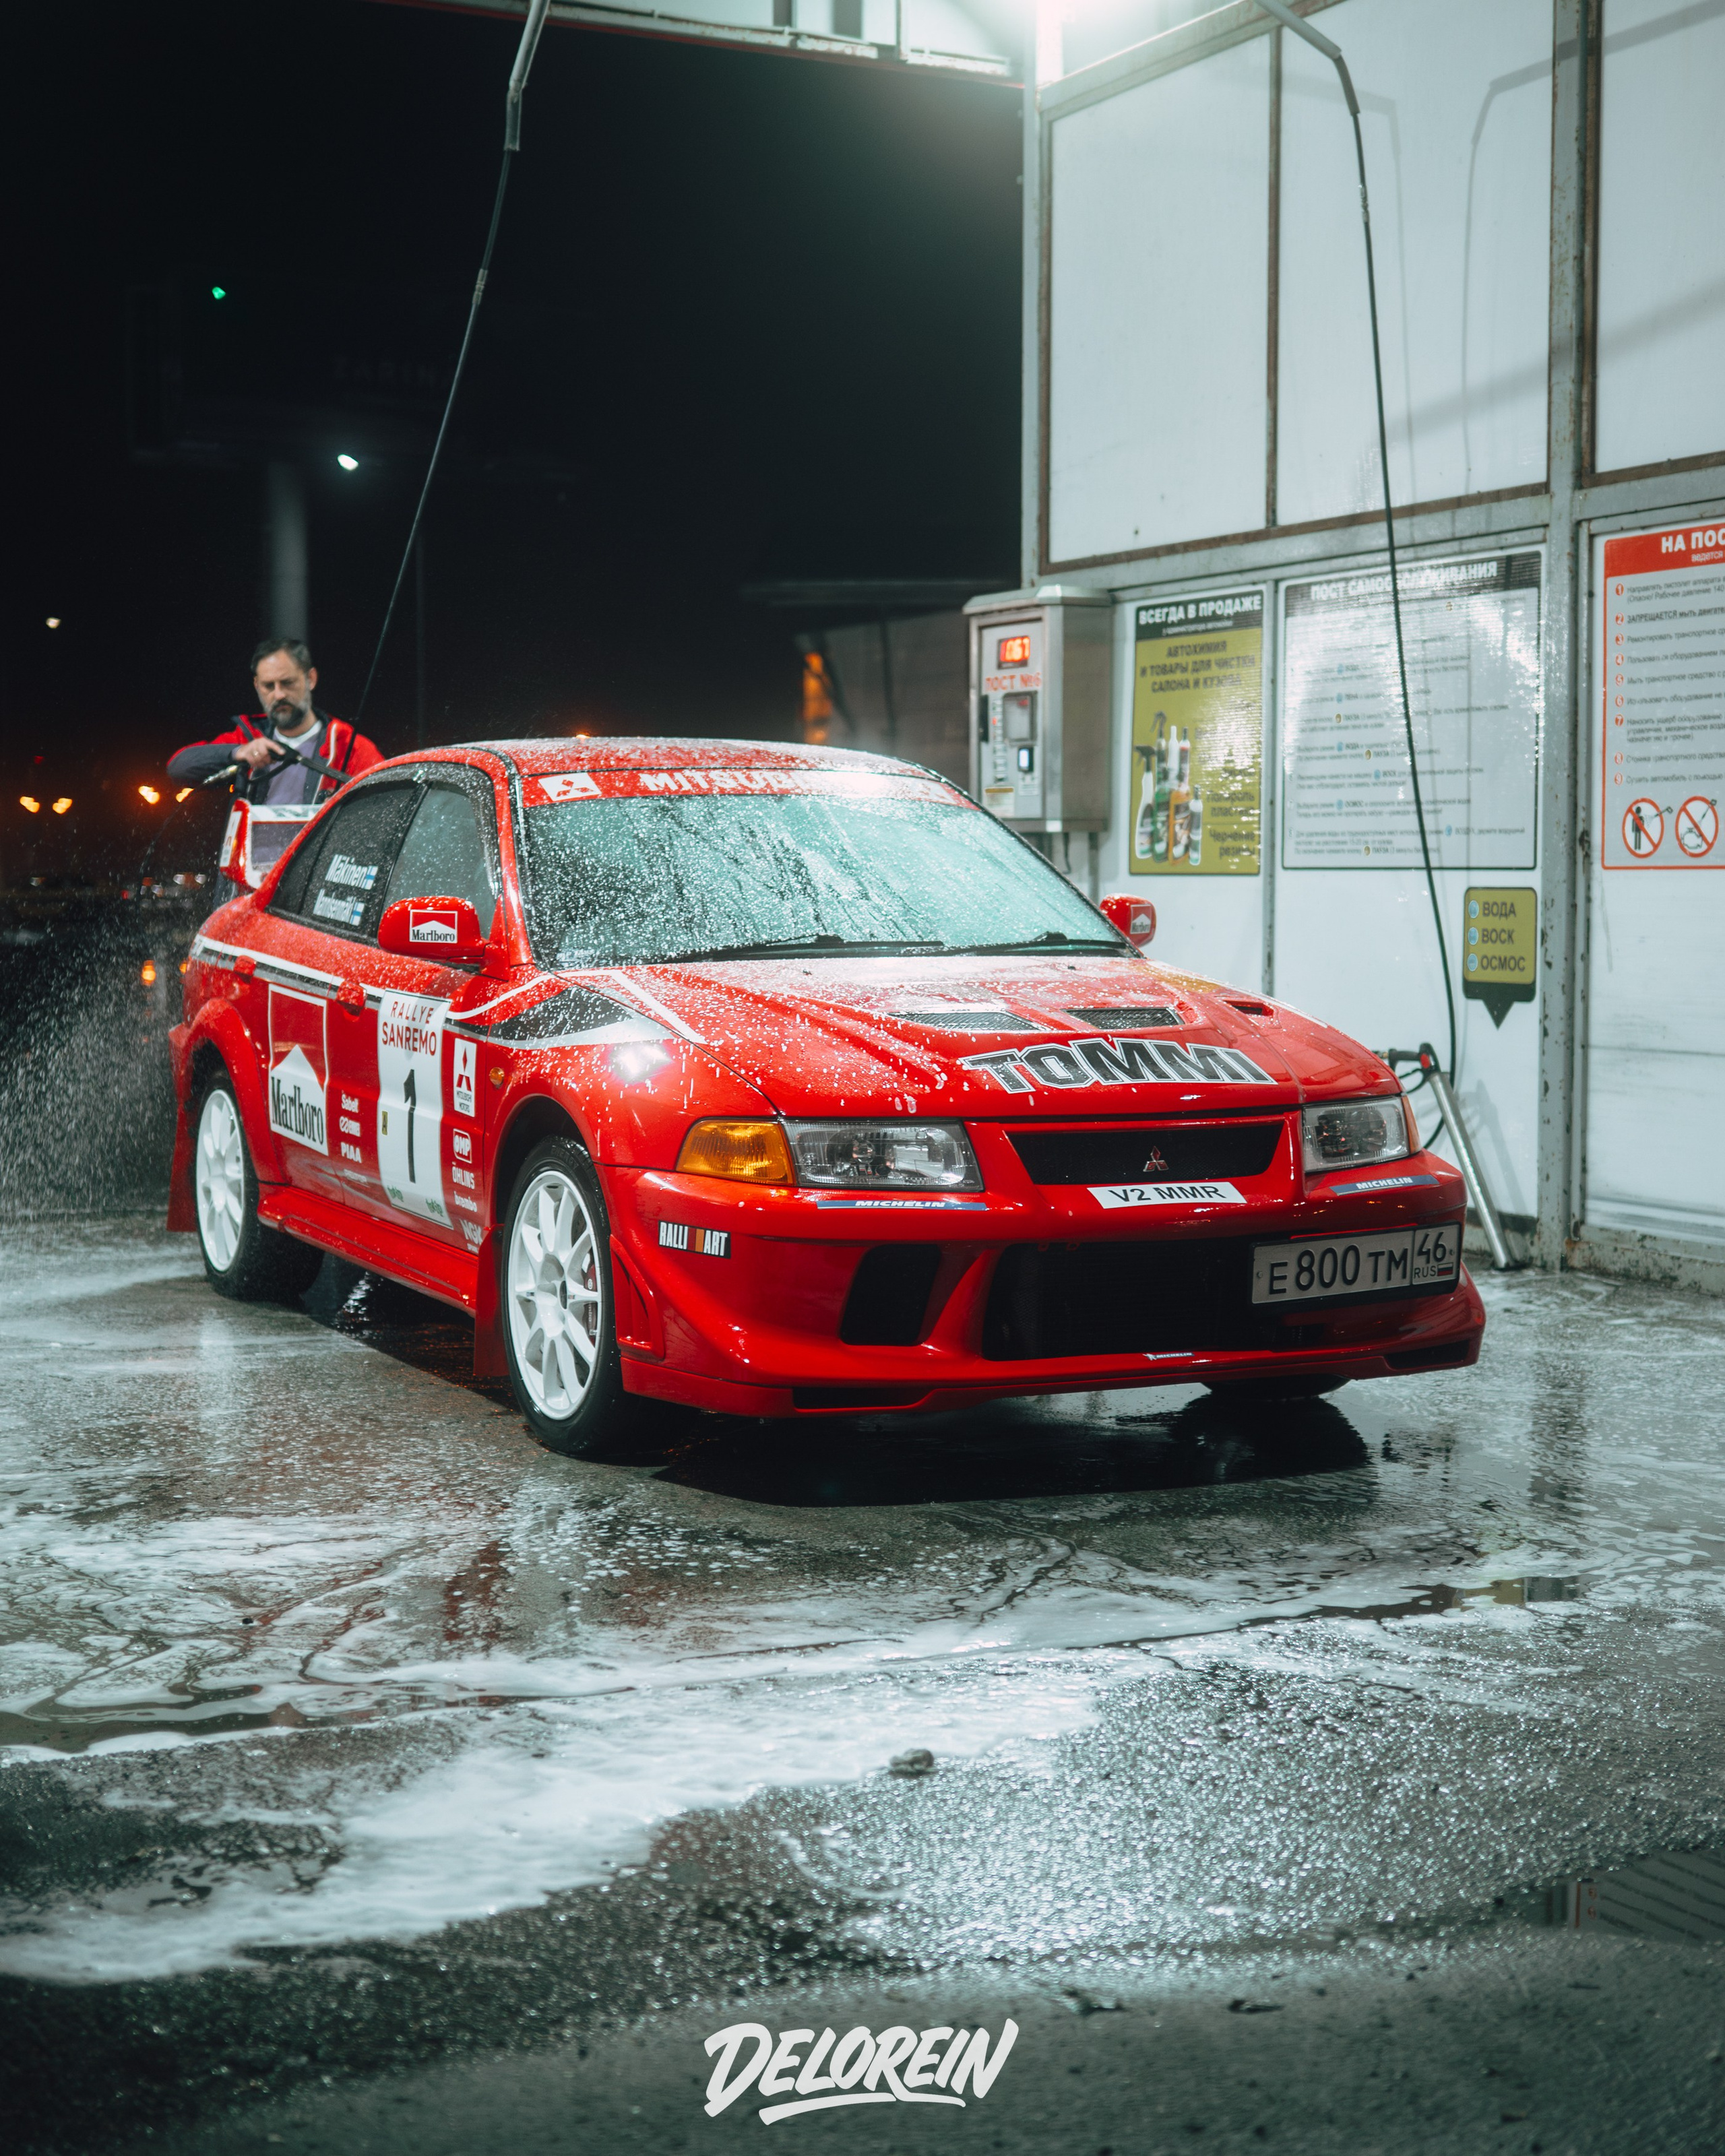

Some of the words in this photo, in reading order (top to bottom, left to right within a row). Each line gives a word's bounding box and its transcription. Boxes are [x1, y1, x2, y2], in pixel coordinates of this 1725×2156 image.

[1662, 534, 1685, 553] НА
[1311, 583, 1346, 600] ПОСТ
[1139, 605, 1185, 625] ВСЕГДА
[1187, 604, 1196, 619] В
[1199, 595, 1261, 616] ПРОДАЖЕ
[1627, 610, 1677, 624] ЗАПРЕЩАЕТСЯ
[1167, 640, 1226, 658] АВТОХИМИЯ
[1140, 667, 1147, 677] И
[1150, 662, 1189, 676] ТОВАРЫ
[1191, 660, 1212, 674] ДЛЯ
[985, 674, 1016, 691] ПОСТ
[1152, 678, 1190, 693] САЛОНА
[1193, 678, 1199, 689] И
[325, 854, 368, 887] Mäkinen
[1482, 901, 1516, 920] ВОДА
[412, 929, 455, 942] Marlboro
[1481, 928, 1515, 944] ВОСК
[1480, 955, 1526, 972] ОСМОС
[391, 1001, 434, 1024] RALLYE
[382, 1021, 437, 1056] SANREMO
[958, 1037, 1278, 1094] TOMMI
[270, 1076, 324, 1145] Marlboro
[404, 1069, 416, 1184] 1
[341, 1142, 362, 1163] PIAA
[454, 1135, 470, 1156] OMP
[1356, 1176, 1414, 1190] MICHELIN
[1108, 1188, 1152, 1203] V2
[1156, 1184, 1228, 1201] MMR
[855, 1200, 945, 1208] MICHELIN
[459, 1218, 482, 1245] NGK
[1417, 1231, 1447, 1265] 46
[1414, 1265, 1437, 1279] RUS
